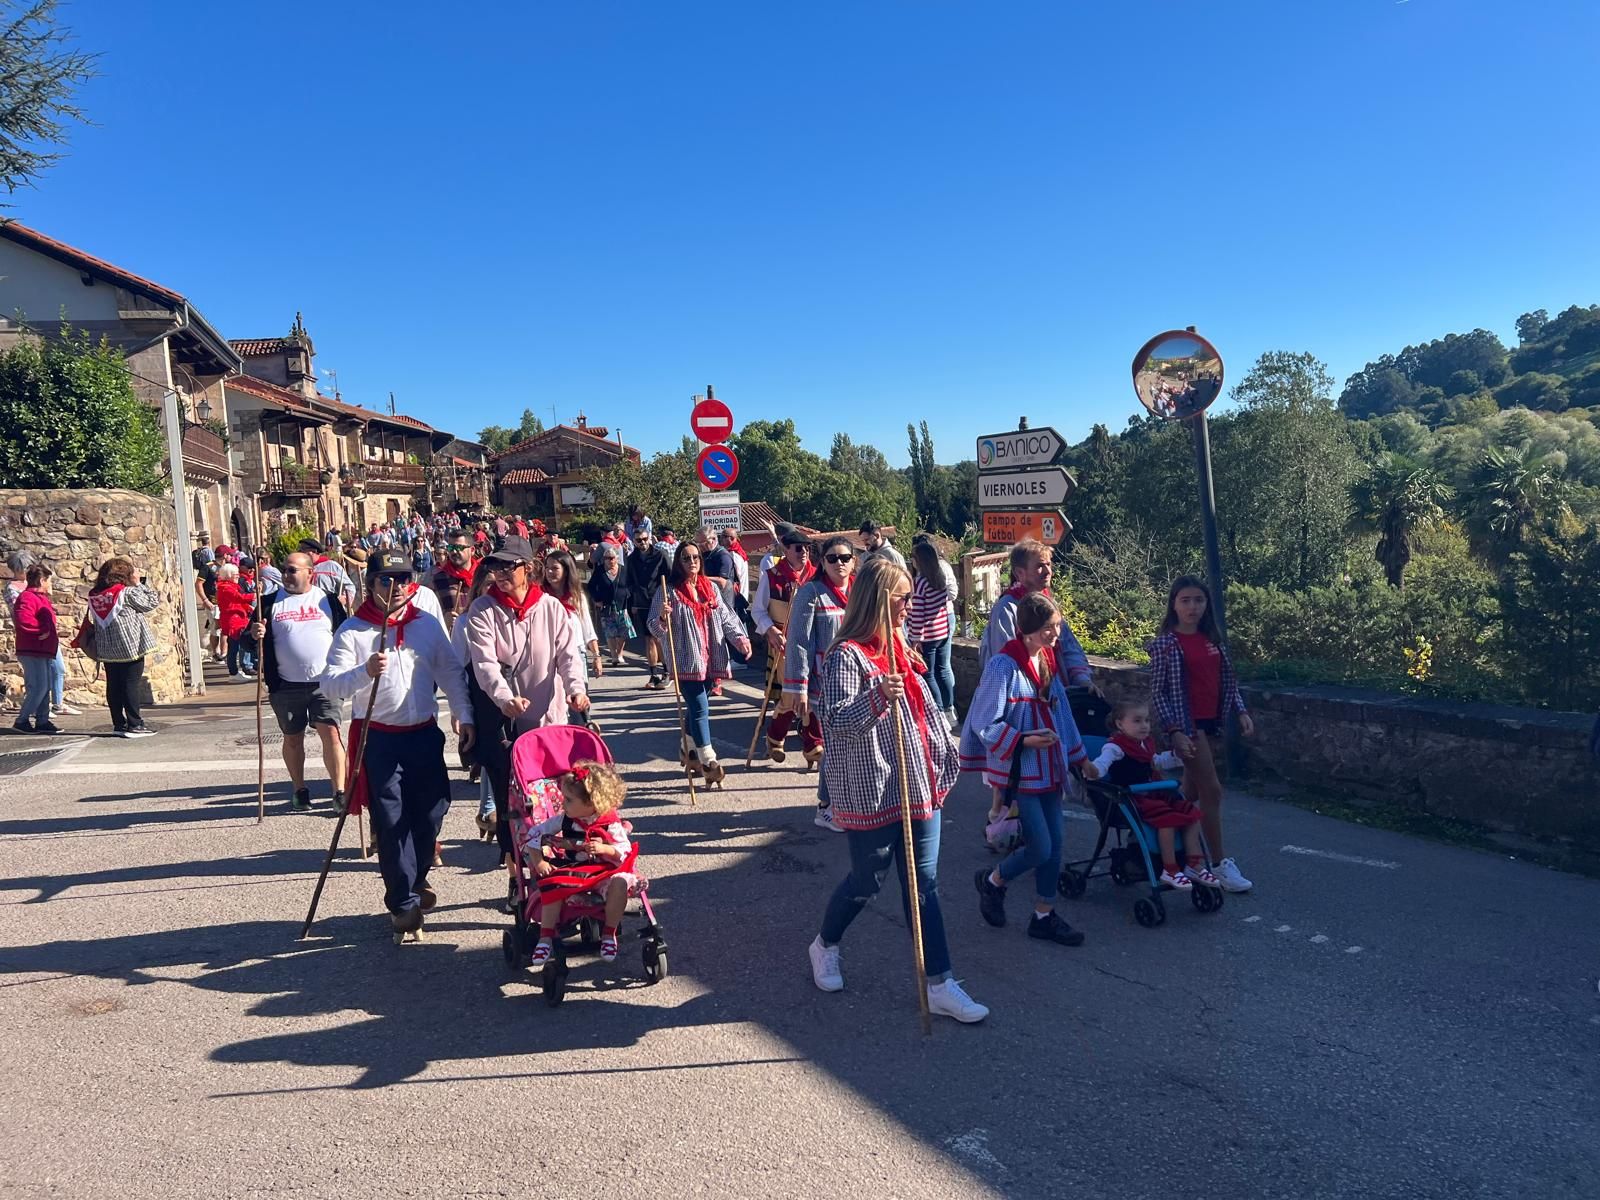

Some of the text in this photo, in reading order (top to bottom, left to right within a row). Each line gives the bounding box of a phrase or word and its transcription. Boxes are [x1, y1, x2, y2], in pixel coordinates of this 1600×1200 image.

[983, 481, 1047, 497] VIERNOLES
[987, 514, 1032, 527] campo de
[988, 528, 1016, 541] fútbol
